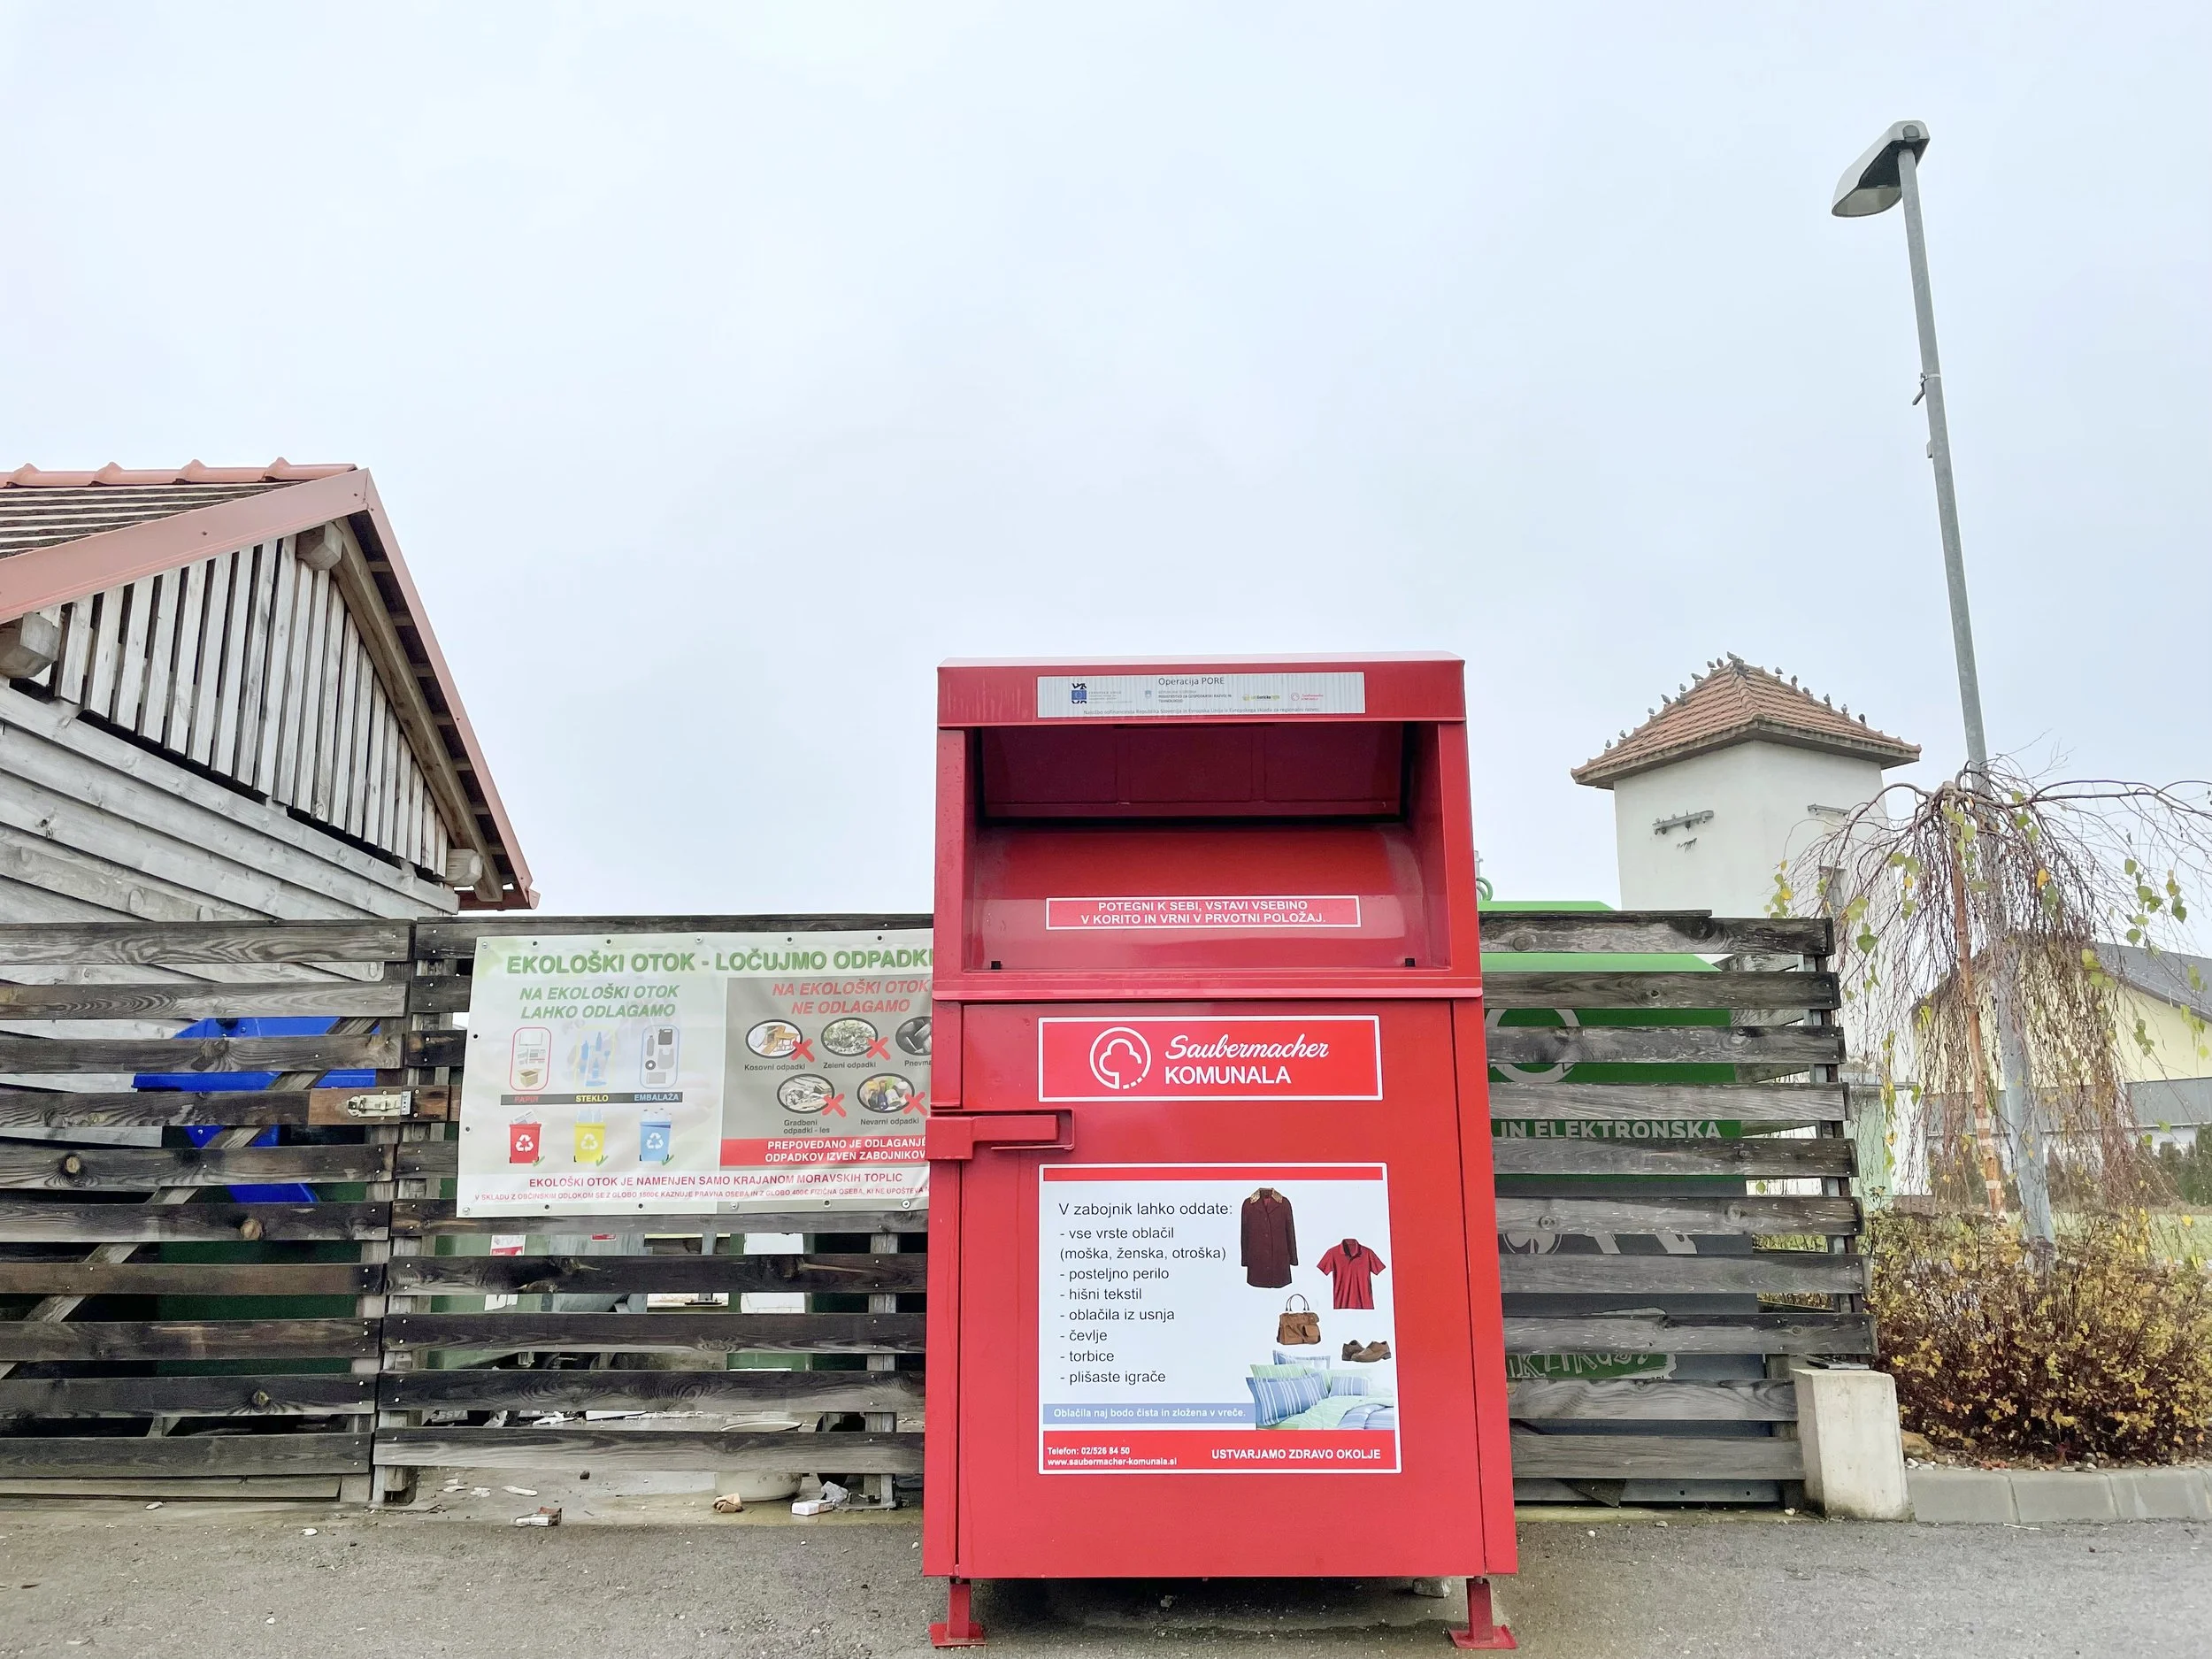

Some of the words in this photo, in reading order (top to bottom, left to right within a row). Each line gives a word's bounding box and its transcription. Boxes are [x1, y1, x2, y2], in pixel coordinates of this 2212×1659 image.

[1158, 678, 1199, 687] Operacija
[1098, 902, 1155, 911] POTEGNI
[1158, 902, 1166, 911] K
[1170, 902, 1202, 912] SEBI,
[1204, 901, 1248, 910] VSTAVI
[1251, 901, 1308, 910] VSEBINO
[1081, 915, 1089, 925] V
[1093, 915, 1141, 925] KORITO
[1144, 914, 1157, 924] IN
[1160, 914, 1191, 924] VRNI
[1193, 914, 1202, 923] V
[1206, 913, 1260, 923] PRVOTNI
[1263, 910, 1325, 923] POLOŽAJ.
[507, 950, 625, 973] EKOLOŠKI
[631, 952, 695, 972] OTOK
[715, 949, 827, 971] LOČUJMO
[833, 949, 933, 969] ODPADKI
[519, 987, 541, 1000] NA
[547, 983, 630, 1000] EKOLOŠKI
[634, 985, 680, 998] OTOK
[772, 983, 795, 996] NA
[799, 979, 880, 995] EKOLOŠKI
[885, 979, 930, 994] OTOK
[520, 1006, 578, 1018] LAHKO
[582, 1004, 676, 1018] ODLAGAMO
[791, 1002, 814, 1015] NE
[818, 998, 910, 1013] ODLAGAMO
[1164, 1033, 1329, 1060] Saubermacher
[776, 1063, 806, 1071] odpadki
[1164, 1065, 1292, 1085] KOMUNALA
[1534, 1120, 1722, 1138] ELEKTRONSKA
[767, 1140, 847, 1149] PREPOVEDANO
[849, 1140, 862, 1148] JE
[765, 1153, 824, 1162] ODPADKOV
[826, 1152, 856, 1161] IZVEN
[859, 1150, 926, 1160] ZABOJNIKOV
[529, 1176, 583, 1187] EKOLOŠKI
[587, 1178, 618, 1187] OTOK
[620, 1177, 634, 1186] JE
[636, 1177, 695, 1186] NAMENJEN
[699, 1176, 730, 1186] SAMO
[733, 1175, 794, 1186] KRAJANOM
[796, 1173, 861, 1183] MORAVSKIH
[864, 1173, 903, 1182] TOPLIC
[1059, 1202, 1069, 1215] V
[1073, 1202, 1133, 1217] zabojnik
[1137, 1202, 1175, 1215] lahko
[1179, 1202, 1233, 1215] oddate:
[1069, 1229, 1092, 1239] vse
[1095, 1228, 1128, 1239] vrste
[1132, 1226, 1174, 1239] oblačil
[1060, 1248, 1112, 1262] (moška,
[1117, 1247, 1168, 1260] ženska,
[1171, 1247, 1226, 1261] otroška)
[1069, 1268, 1129, 1282] posteljno
[1133, 1267, 1170, 1282] perilo
[1069, 1288, 1100, 1300] hišni
[1103, 1288, 1142, 1300] tekstil
[1069, 1309, 1119, 1320] oblačila
[1125, 1309, 1134, 1320] iz
[1139, 1309, 1175, 1323] usnja
[1069, 1330, 1108, 1343] čevlje
[1069, 1350, 1114, 1362] torbice
[1069, 1371, 1120, 1386] plišaste
[1125, 1371, 1166, 1385] igrače
[1054, 1408, 1091, 1417] Oblačila
[1094, 1409, 1108, 1418] naj
[1110, 1408, 1134, 1417] bodo
[1136, 1408, 1159, 1417] čista
[1161, 1408, 1170, 1417] in
[1171, 1408, 1208, 1417] zložena
[1217, 1408, 1246, 1417] vreče.
[1211, 1449, 1286, 1459] USTVARJAMO
[1288, 1449, 1333, 1459] ZDRAVO
[1336, 1449, 1380, 1459] OKOLJE
